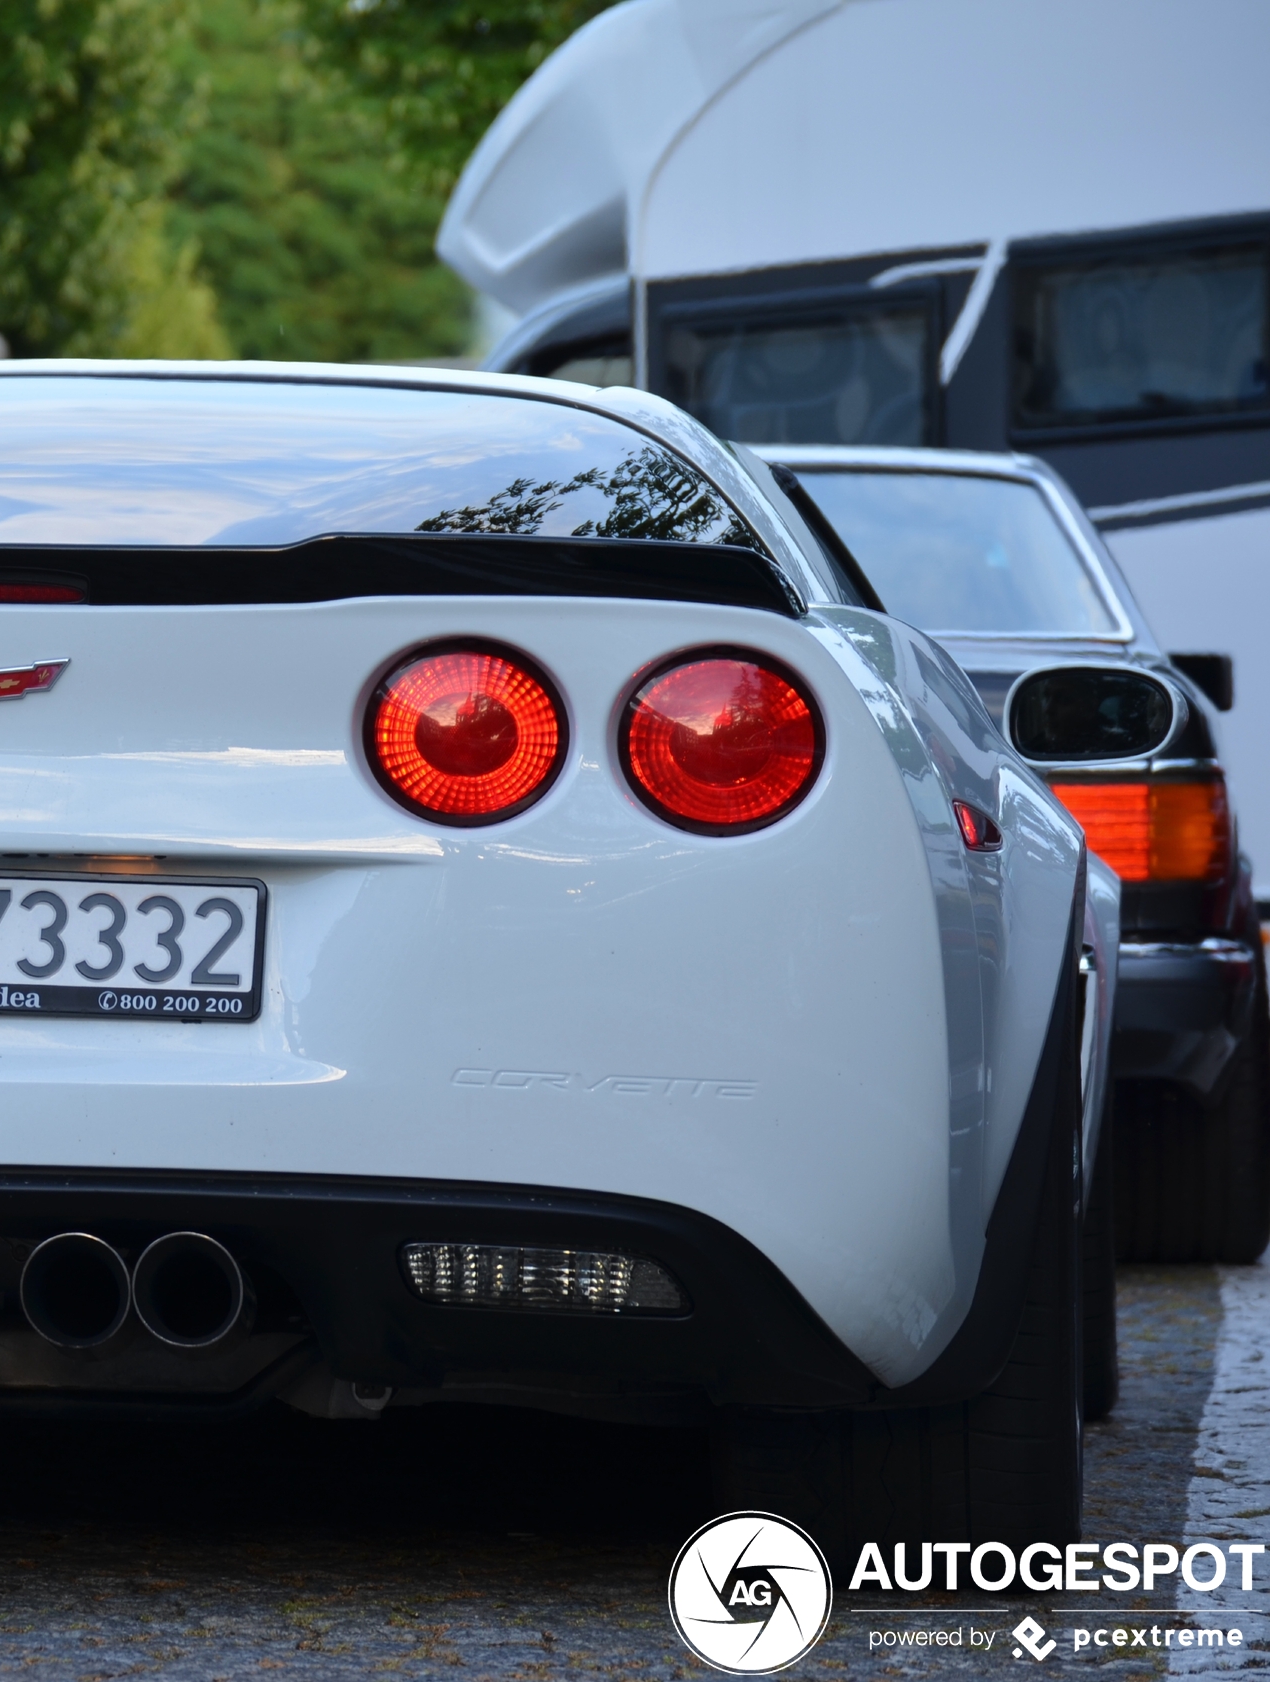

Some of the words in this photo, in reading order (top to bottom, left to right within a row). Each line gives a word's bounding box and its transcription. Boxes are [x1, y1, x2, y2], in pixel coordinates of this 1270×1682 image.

[120, 994, 157, 1011] 800
[163, 995, 200, 1012] 200
[205, 997, 243, 1014] 200
[450, 1067, 761, 1099] CORVETTE
